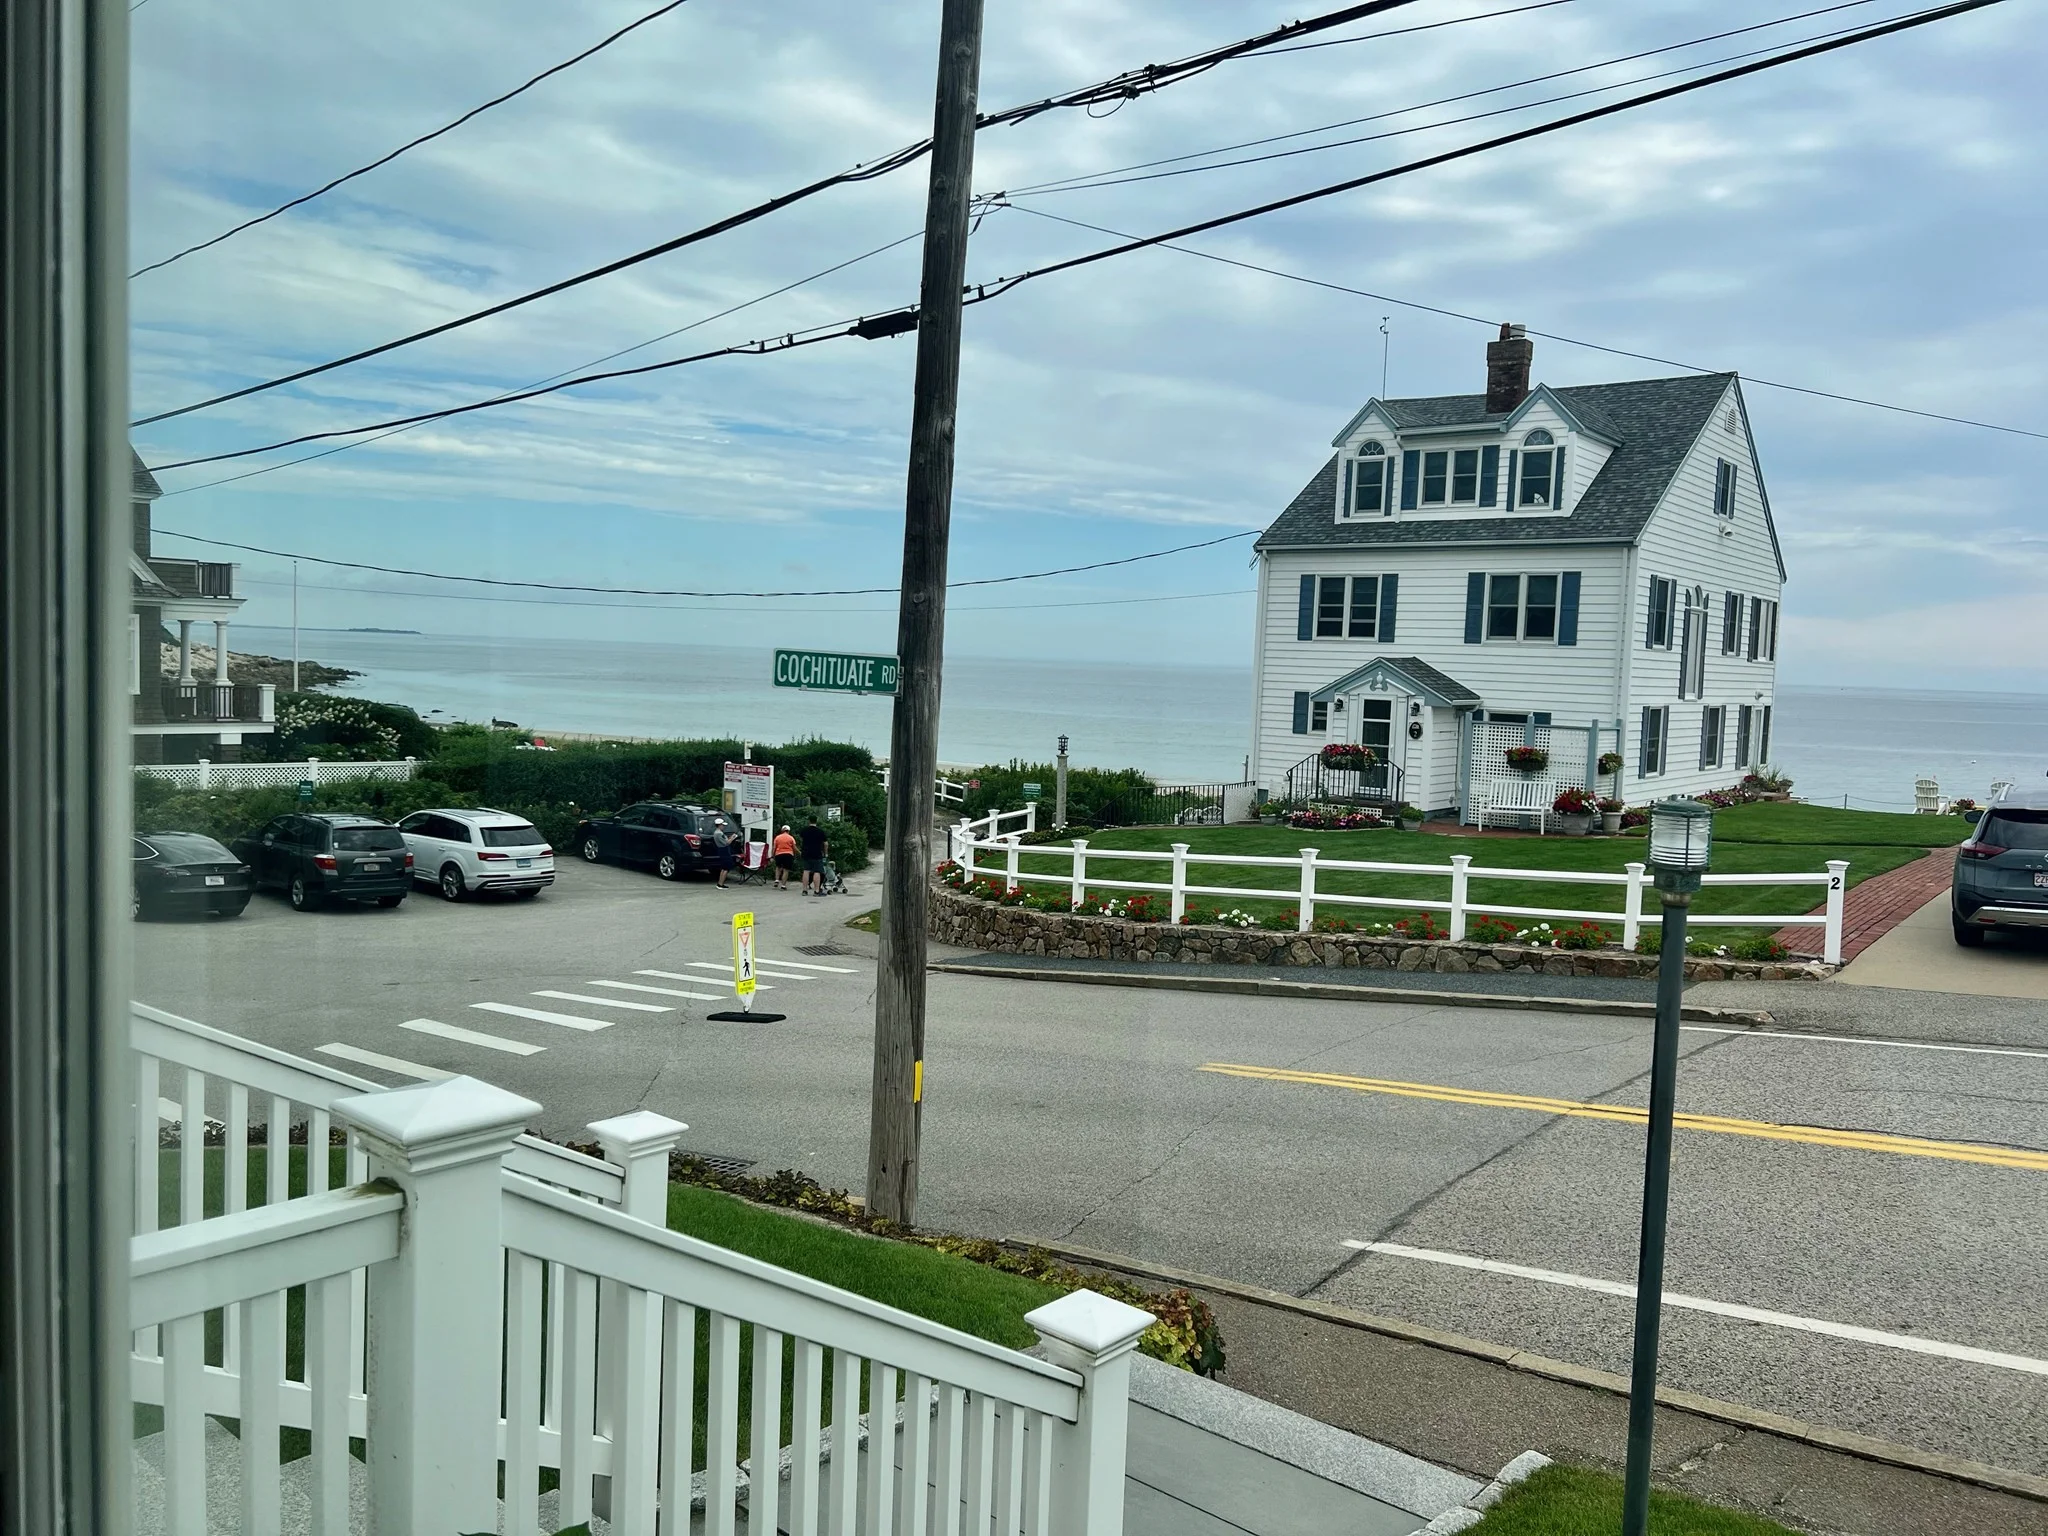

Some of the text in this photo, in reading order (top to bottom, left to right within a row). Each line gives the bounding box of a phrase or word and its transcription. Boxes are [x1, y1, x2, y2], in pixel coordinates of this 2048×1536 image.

[777, 653, 896, 687] COCHITUATE RD
[1830, 876, 1840, 890] 2
[738, 913, 751, 921] STATE
